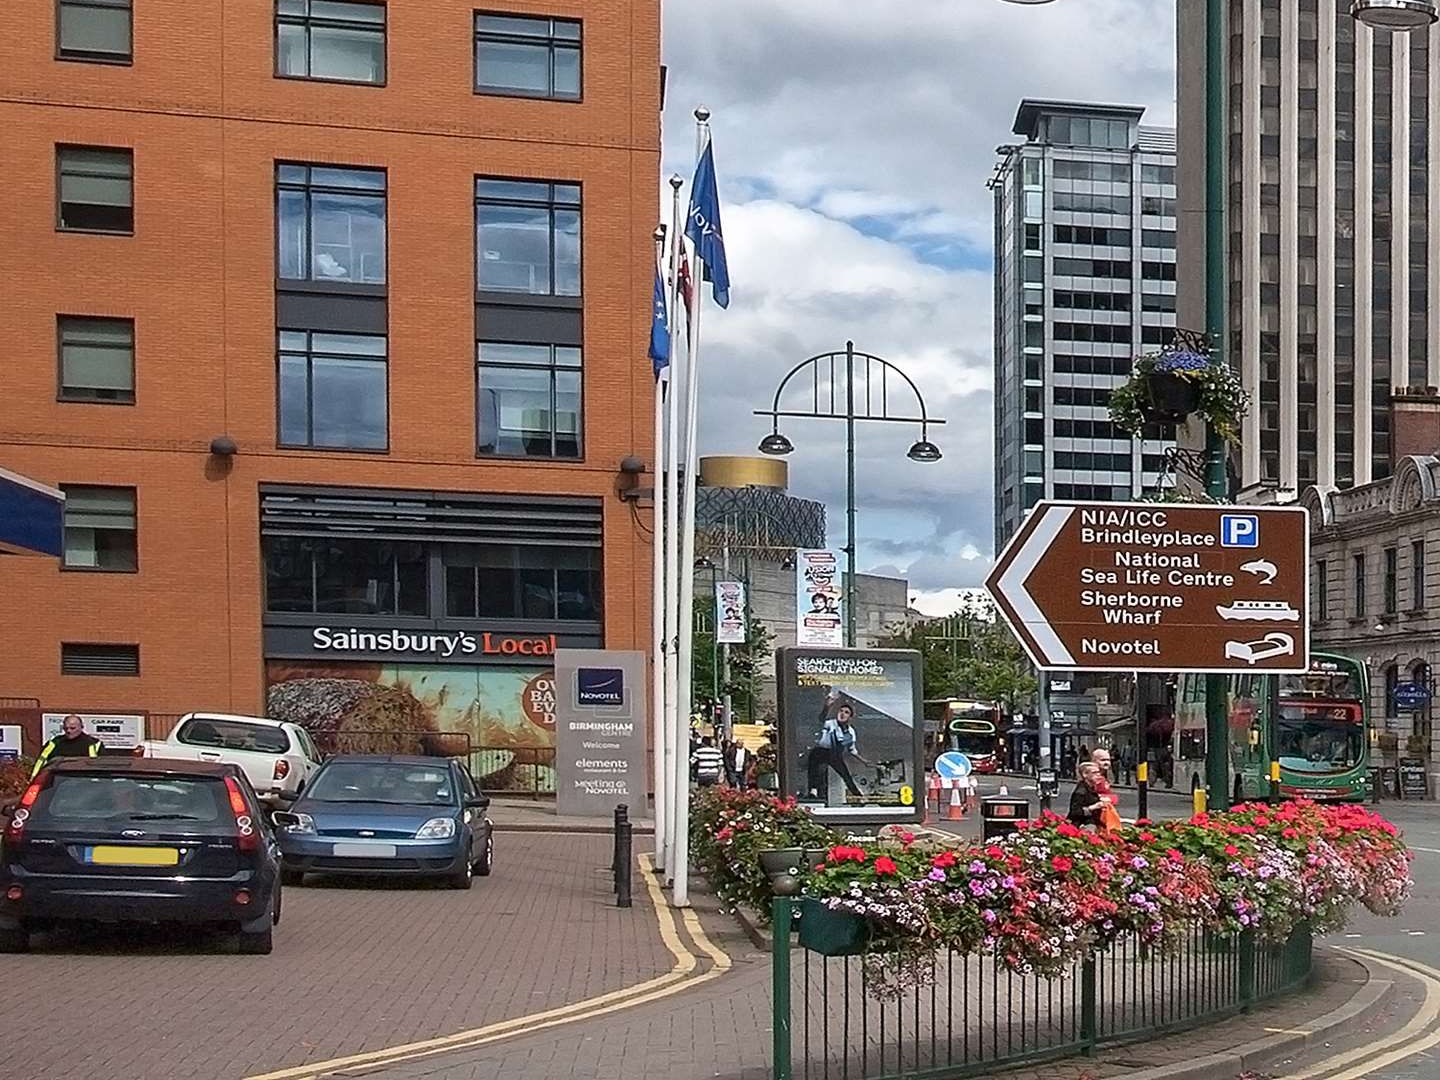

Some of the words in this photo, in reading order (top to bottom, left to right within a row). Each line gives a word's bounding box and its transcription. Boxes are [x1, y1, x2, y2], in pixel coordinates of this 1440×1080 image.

[1081, 509, 1167, 528] NIA/ICC
[1081, 528, 1216, 547] Brindleyplace
[1230, 518, 1253, 544] P
[1115, 551, 1200, 568] National
[1081, 570, 1117, 585] Sea
[1126, 570, 1161, 586] Life
[1167, 571, 1234, 587] Centre
[1081, 590, 1183, 608] Sherborne
[1103, 608, 1162, 625] Wharf
[313, 626, 477, 657] Sainsbury's
[482, 634, 556, 655] Local
[1081, 638, 1161, 655] Novotel
[797, 657, 855, 666] SEARCHING
[857, 658, 877, 666] FOR
[797, 665, 835, 674] SIGNAL
[836, 666, 848, 674] AT
[849, 666, 884, 675] HOME?
[580, 692, 621, 700] NOVOTEL
[1334, 708, 1347, 720] 22
[569, 722, 634, 731] BIRMINGHAM
[582, 741, 621, 750] Welcome
[575, 758, 628, 769] elements
[585, 787, 629, 795] NOVOTEL
